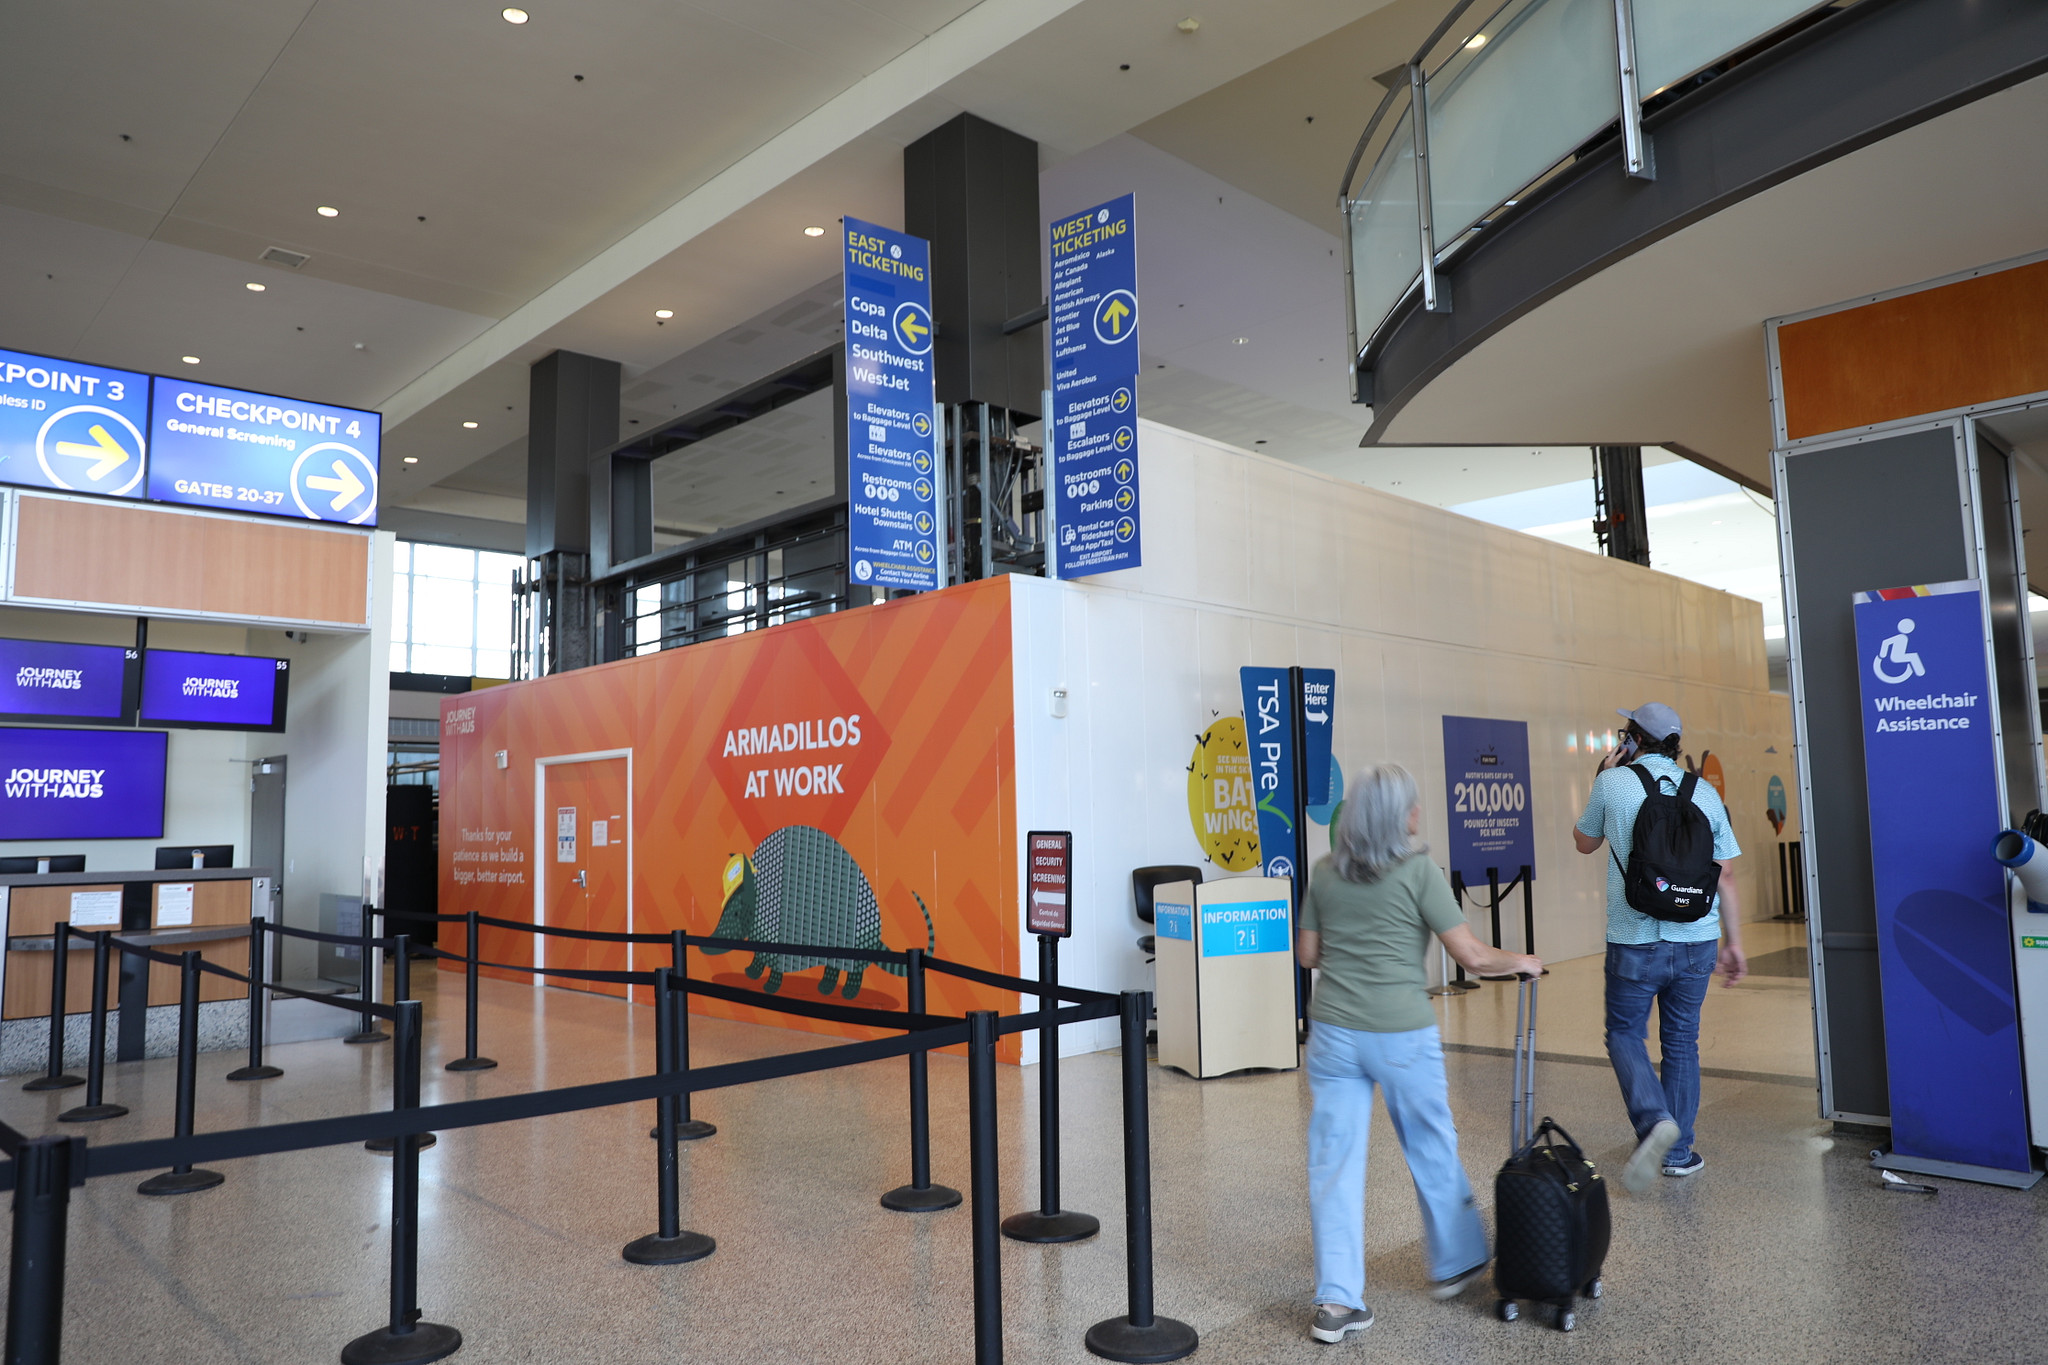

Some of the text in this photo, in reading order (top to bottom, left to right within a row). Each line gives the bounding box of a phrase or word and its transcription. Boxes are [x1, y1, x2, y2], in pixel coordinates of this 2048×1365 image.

[1052, 214, 1093, 240] WEST
[849, 231, 886, 254] EAST
[1052, 219, 1126, 257] TICKETING
[1096, 249, 1115, 259] Alaska
[849, 248, 924, 282] TICKETING
[1054, 263, 1088, 280] Air Canada
[1055, 276, 1082, 291] Allegiant
[1055, 288, 1084, 302] American
[1055, 293, 1100, 313] British Airways
[851, 296, 886, 317] Copa
[1056, 311, 1080, 324] Frontier
[852, 320, 888, 341] Delta
[1056, 322, 1080, 335] Jet Blue
[1056, 336, 1069, 346] KLM
[852, 344, 924, 372] Southwest
[1056, 344, 1086, 358] Lufthansa
[853, 366, 910, 391] WestJet
[1056, 368, 1077, 380] United
[107, 381, 125, 401] 3
[1056, 374, 1097, 392] Viva Aerobus
[32, 399, 46, 411] ID
[868, 403, 910, 421] Elevators
[1068, 395, 1110, 414] Elevators
[176, 392, 361, 439] CHECKPOINT 4
[854, 412, 910, 430] to Baggage Level
[1064, 410, 1092, 424] Baggage
[1092, 404, 1110, 416] Level
[166, 418, 296, 451] General Screening
[1068, 432, 1110, 450] Escalators
[869, 444, 911, 460] Elevators
[1058, 442, 1113, 464] to Baggage Level
[862, 472, 912, 490] Restrooms
[1064, 466, 1112, 484] Restrooms
[175, 479, 284, 505] GATES 20-37
[855, 503, 912, 521] Hotel Shuttle
[1080, 499, 1114, 513] Parking
[873, 518, 913, 530] Downstairs
[1078, 520, 1114, 533] Rental Cars
[1082, 529, 1114, 542] Rideshare
[893, 540, 912, 551] ATM
[1070, 538, 1114, 553] Ride App/Taxi
[1091, 549, 1113, 558] AIRPORT
[1065, 560, 1085, 569] FOLLOW
[1086, 556, 1115, 565] PEDESTRIAN
[880, 568, 900, 576] Contact
[125, 649, 138, 660] 56
[16, 666, 82, 680] JOURNEY
[276, 660, 288, 670] 55
[16, 676, 82, 690] WITHAUS
[182, 677, 240, 690] JOURNEY
[1304, 682, 1330, 694] Enter
[182, 686, 239, 699] WITHAUS
[1304, 694, 1328, 705] Here
[1874, 692, 1977, 712] Wheelchair
[446, 706, 476, 724] JOURNEY
[1875, 716, 1970, 733] Assistance
[723, 714, 861, 757] ARMADILLOS
[1257, 679, 1281, 790] TSA Pre
[1217, 755, 1249, 764] SEE WING
[4, 768, 105, 784] JOURNEY
[1216, 765, 1224, 773] IN
[1225, 765, 1237, 773] THE
[744, 764, 844, 798] AT WORK
[4, 782, 104, 799] WITHAUS
[1454, 782, 1525, 816] 210,000
[1464, 818, 1519, 829] POUNDS OF INSECTS
[462, 827, 512, 845] Thanks for your
[1480, 828, 1505, 837] PER WEEK
[1036, 840, 1062, 849] GENERAL
[453, 848, 524, 864] patience as we build a
[1036, 856, 1063, 866] SECURITY
[454, 867, 524, 887] bigger, better airport.
[1033, 873, 1065, 884] SCREENING
[1671, 884, 1703, 894] Guardians
[1039, 909, 1053, 917] Control
[1157, 905, 1189, 916] INFORMATION
[1204, 908, 1286, 924] INFORMATION
[1032, 919, 1065, 928] Seguridad General
